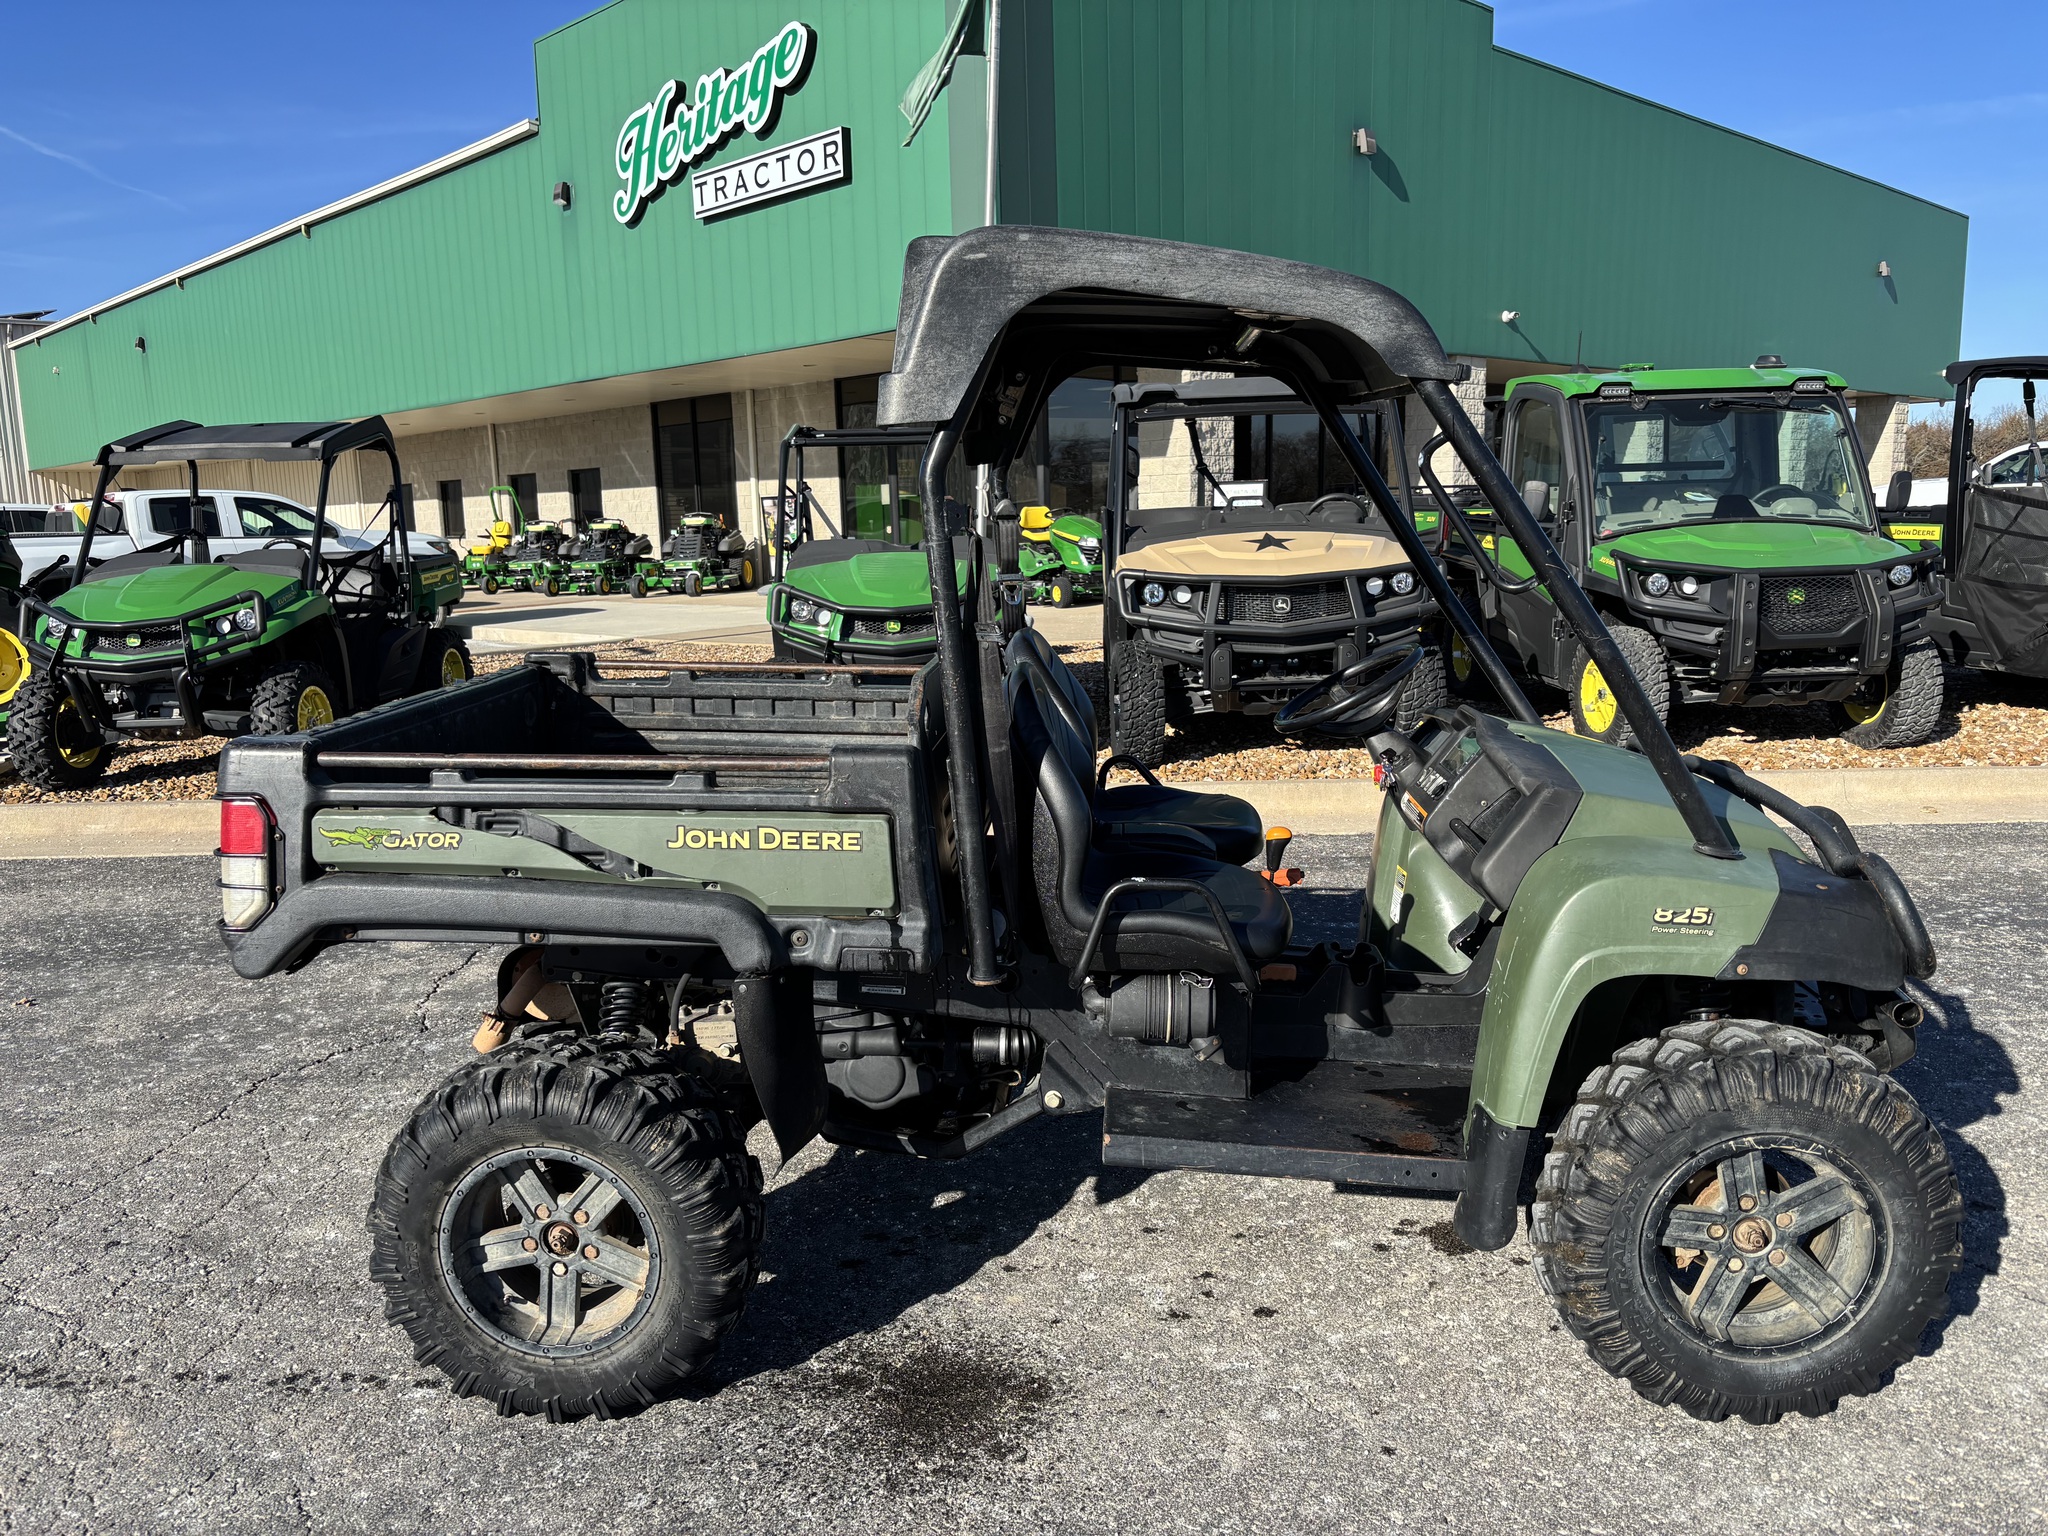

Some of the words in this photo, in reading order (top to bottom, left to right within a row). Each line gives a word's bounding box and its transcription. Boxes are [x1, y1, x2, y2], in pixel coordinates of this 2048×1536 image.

[615, 23, 805, 221] Heritage
[694, 140, 841, 207] TRACTOR
[1892, 528, 1911, 536] JOHN
[1911, 528, 1936, 537] DEERE
[382, 829, 462, 850] GATOR
[667, 825, 751, 850] JOHN
[757, 825, 862, 851] DEERE
[1653, 906, 1714, 925] 825i
[1651, 926, 1678, 934] Power
[1679, 927, 1715, 936] Steering
[1619, 1176, 1649, 1223] ATR
[1611, 1228, 1631, 1297] TRAIL
